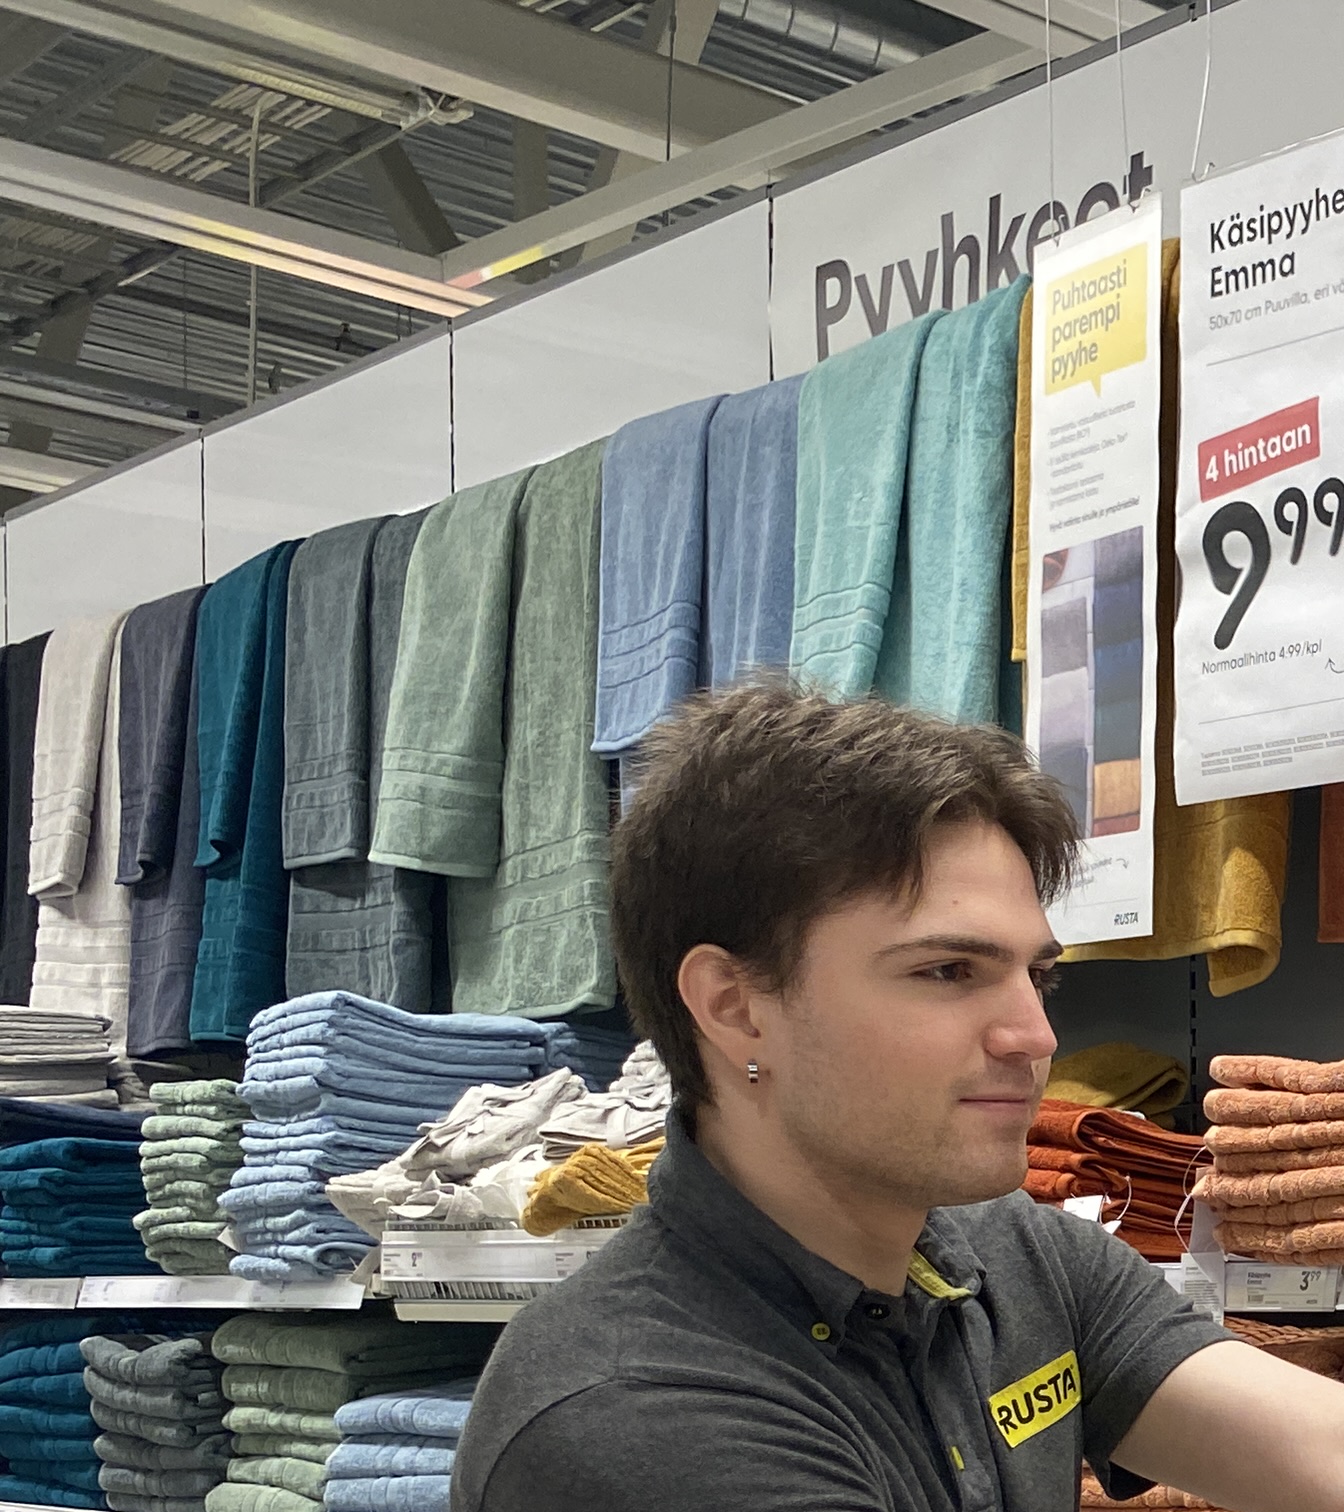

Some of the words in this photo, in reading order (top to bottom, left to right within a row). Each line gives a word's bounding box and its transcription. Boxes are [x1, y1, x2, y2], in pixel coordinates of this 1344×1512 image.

[1051, 258, 1128, 316] Puhtaasti
[1210, 251, 1296, 299] Emma
[1051, 293, 1121, 353] parempi
[1209, 309, 1242, 331] 50x70
[1244, 305, 1262, 321] cm
[1314, 283, 1330, 301] eri
[1051, 340, 1099, 384] pyyhe
[1205, 455, 1219, 483] 4
[1225, 423, 1312, 476] hintaan
[1201, 649, 1276, 675] Normaalihinta
[1113, 912, 1139, 926] RUSTA
[997, 1367, 1077, 1435] RUSTA
